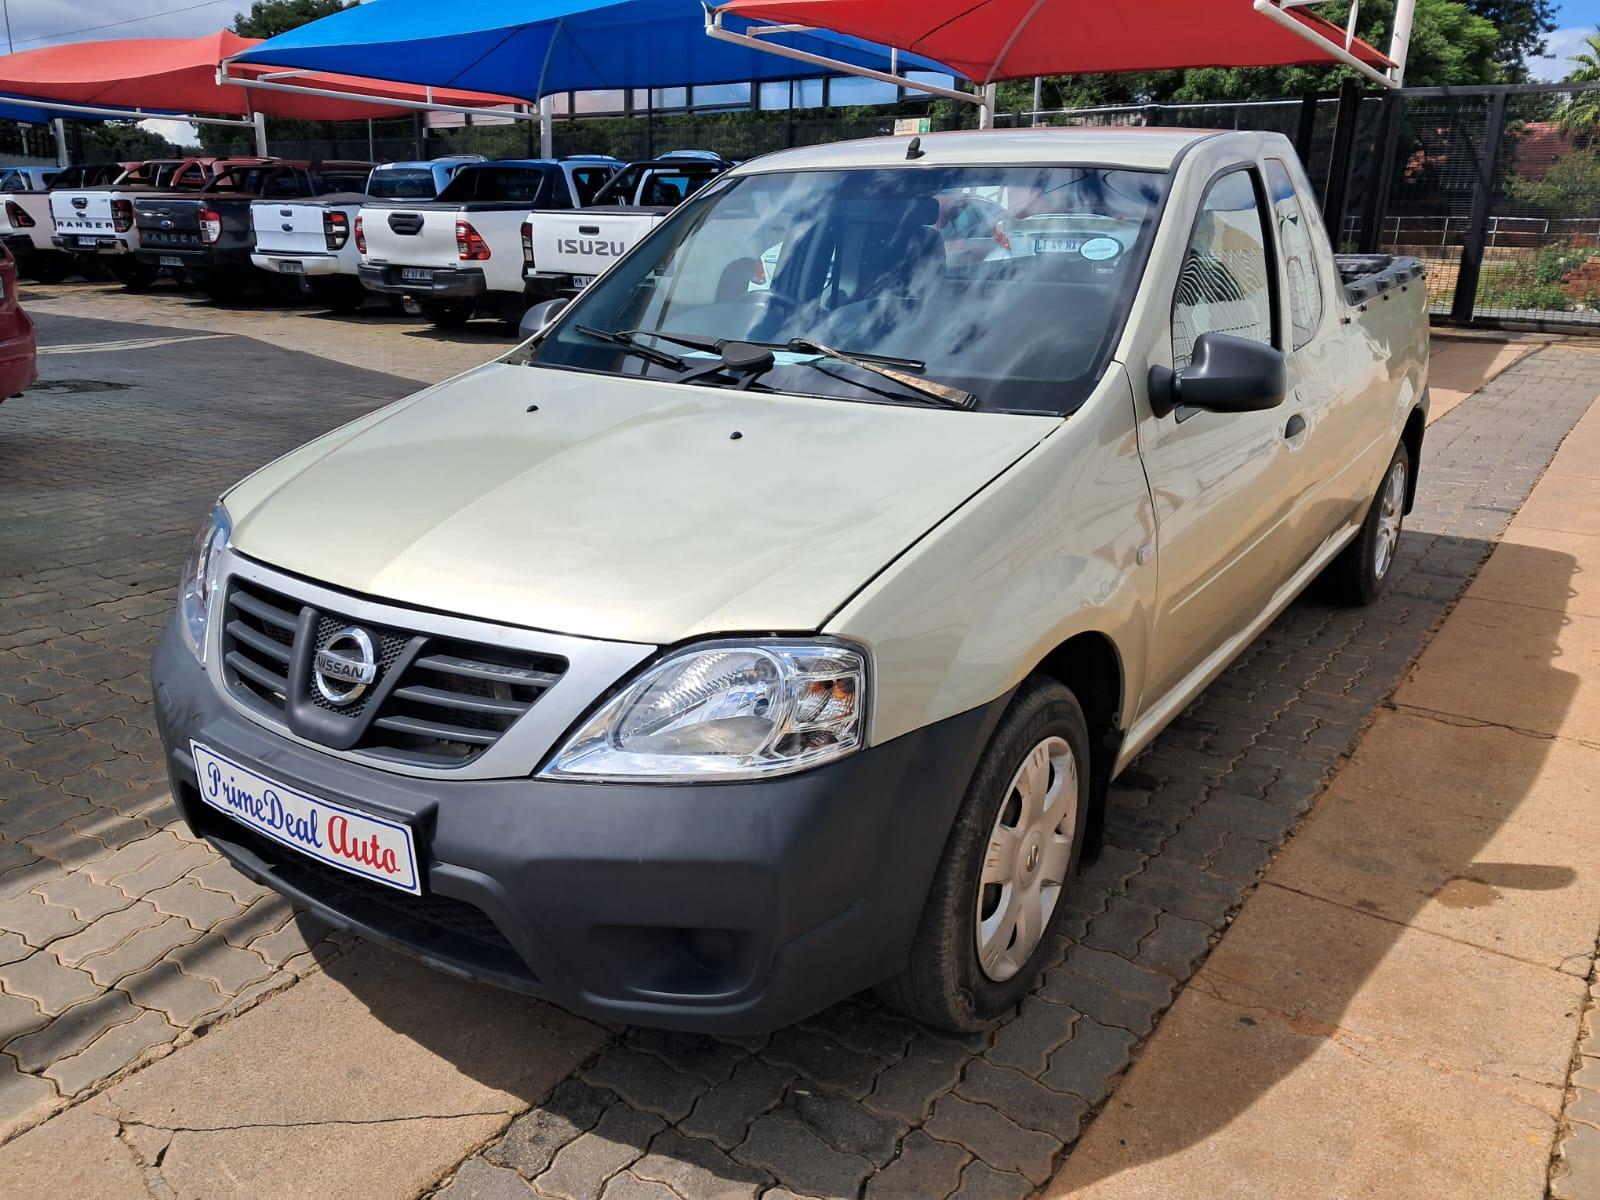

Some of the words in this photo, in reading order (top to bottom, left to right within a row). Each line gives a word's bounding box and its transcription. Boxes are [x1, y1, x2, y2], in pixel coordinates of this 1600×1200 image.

[57, 221, 113, 229] RANGER
[143, 233, 199, 243] RANGER
[558, 239, 624, 257] ISUZU
[317, 655, 365, 679] NISSAN
[207, 760, 323, 849] PrimeDeal
[327, 815, 401, 875] Auto
